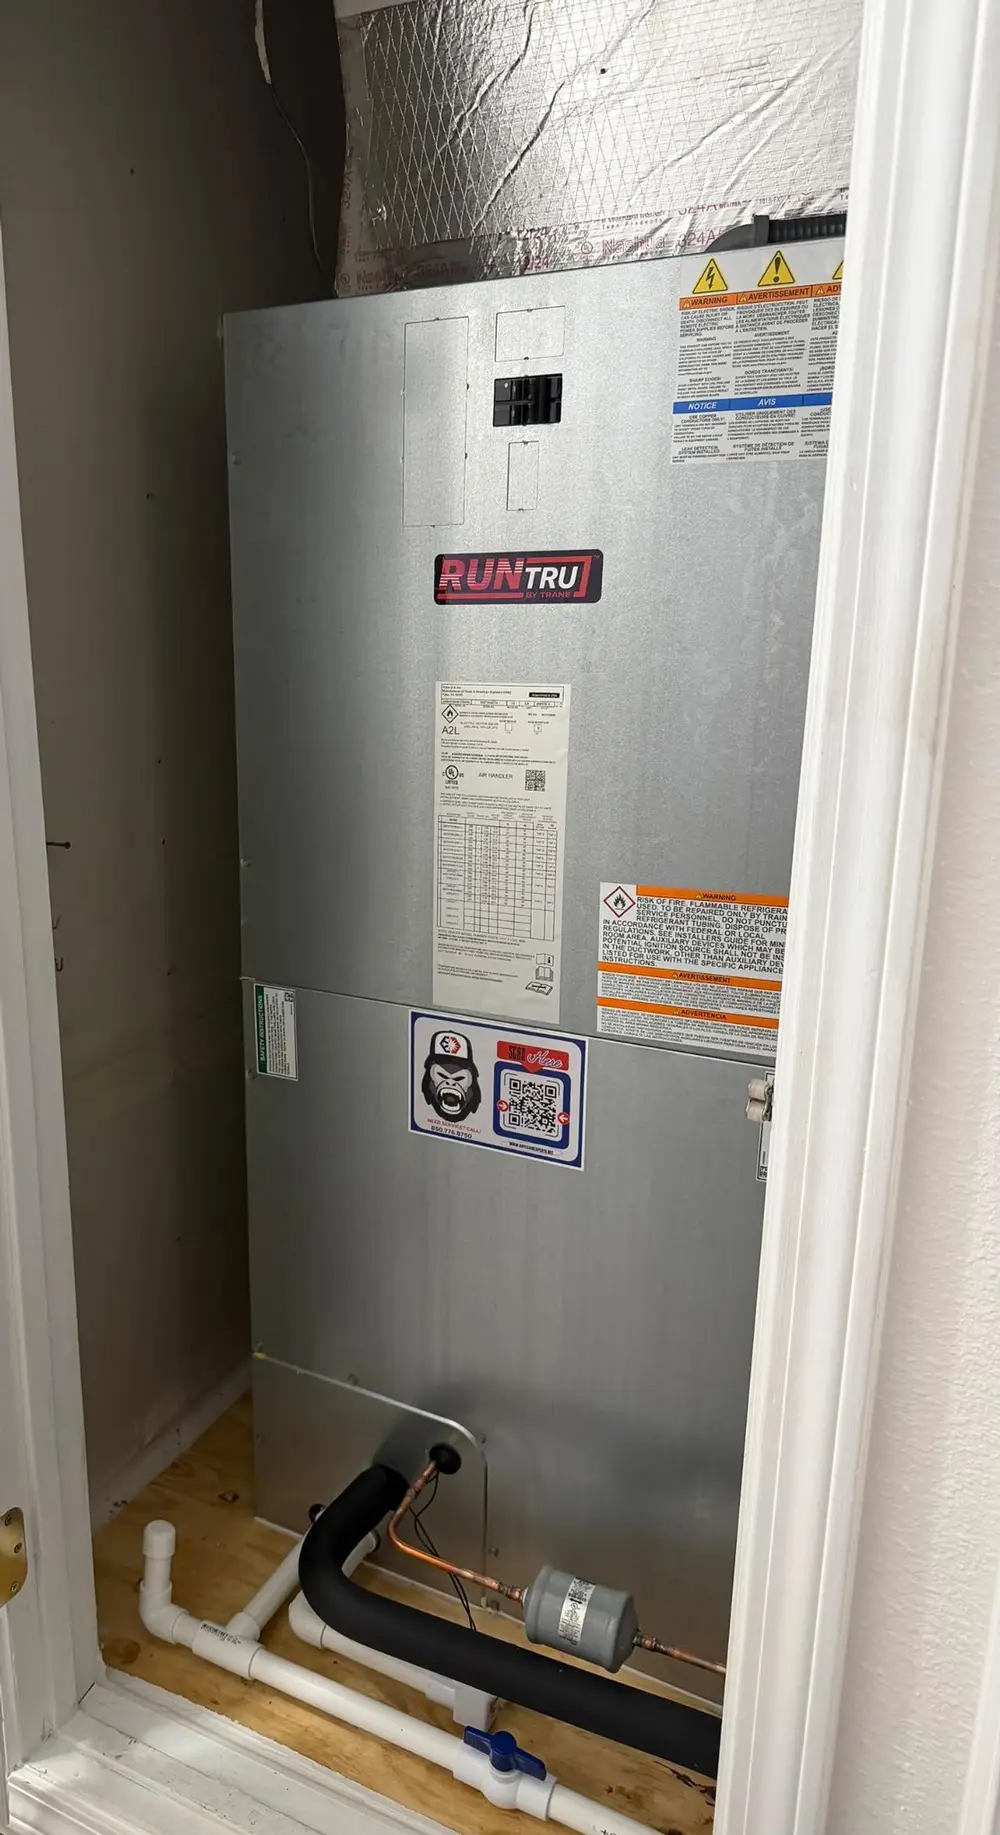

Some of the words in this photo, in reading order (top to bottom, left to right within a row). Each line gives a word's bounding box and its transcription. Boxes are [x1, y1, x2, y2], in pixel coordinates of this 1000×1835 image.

[748, 288, 809, 300] AVERTISSEMENT
[692, 296, 728, 305] WARNING
[688, 402, 717, 410] NOTICE
[442, 726, 460, 735] A2L
[702, 893, 736, 901] WARNING
[686, 907, 724, 915] REPAIRED
[690, 901, 738, 910] FLAMMABLE
[741, 905, 788, 914] REFRIGERA
[637, 916, 688, 925] REFRIGERANT
[725, 923, 760, 931] DISPOSE
[671, 913, 719, 921] PERSONNEL.
[755, 919, 787, 927] PUNCTU
[603, 926, 656, 935] REGULATIONS.
[675, 932, 721, 941] INSTALLERS
[612, 921, 663, 930] ACCORDANCE
[687, 927, 722, 935] FEDERAL
[603, 938, 642, 946] POTENTIAL
[645, 942, 677, 950] IGNITION
[679, 945, 711, 953] SOURCE
[651, 936, 689, 945] AUXILIARY
[692, 940, 725, 948] DEVICES
[602, 956, 658, 966] INSTRUCTIONS.
[628, 946, 671, 955] DUCTWORK.
[726, 956, 767, 965] AUXILIARY
[701, 960, 736, 968] SPECIFIC
[738, 964, 783, 973] APPLIANCE
[679, 973, 730, 983] AVERTISSEMENT
[681, 1010, 727, 1020] ADVERTENCIA
[527, 1050, 563, 1068] Here
